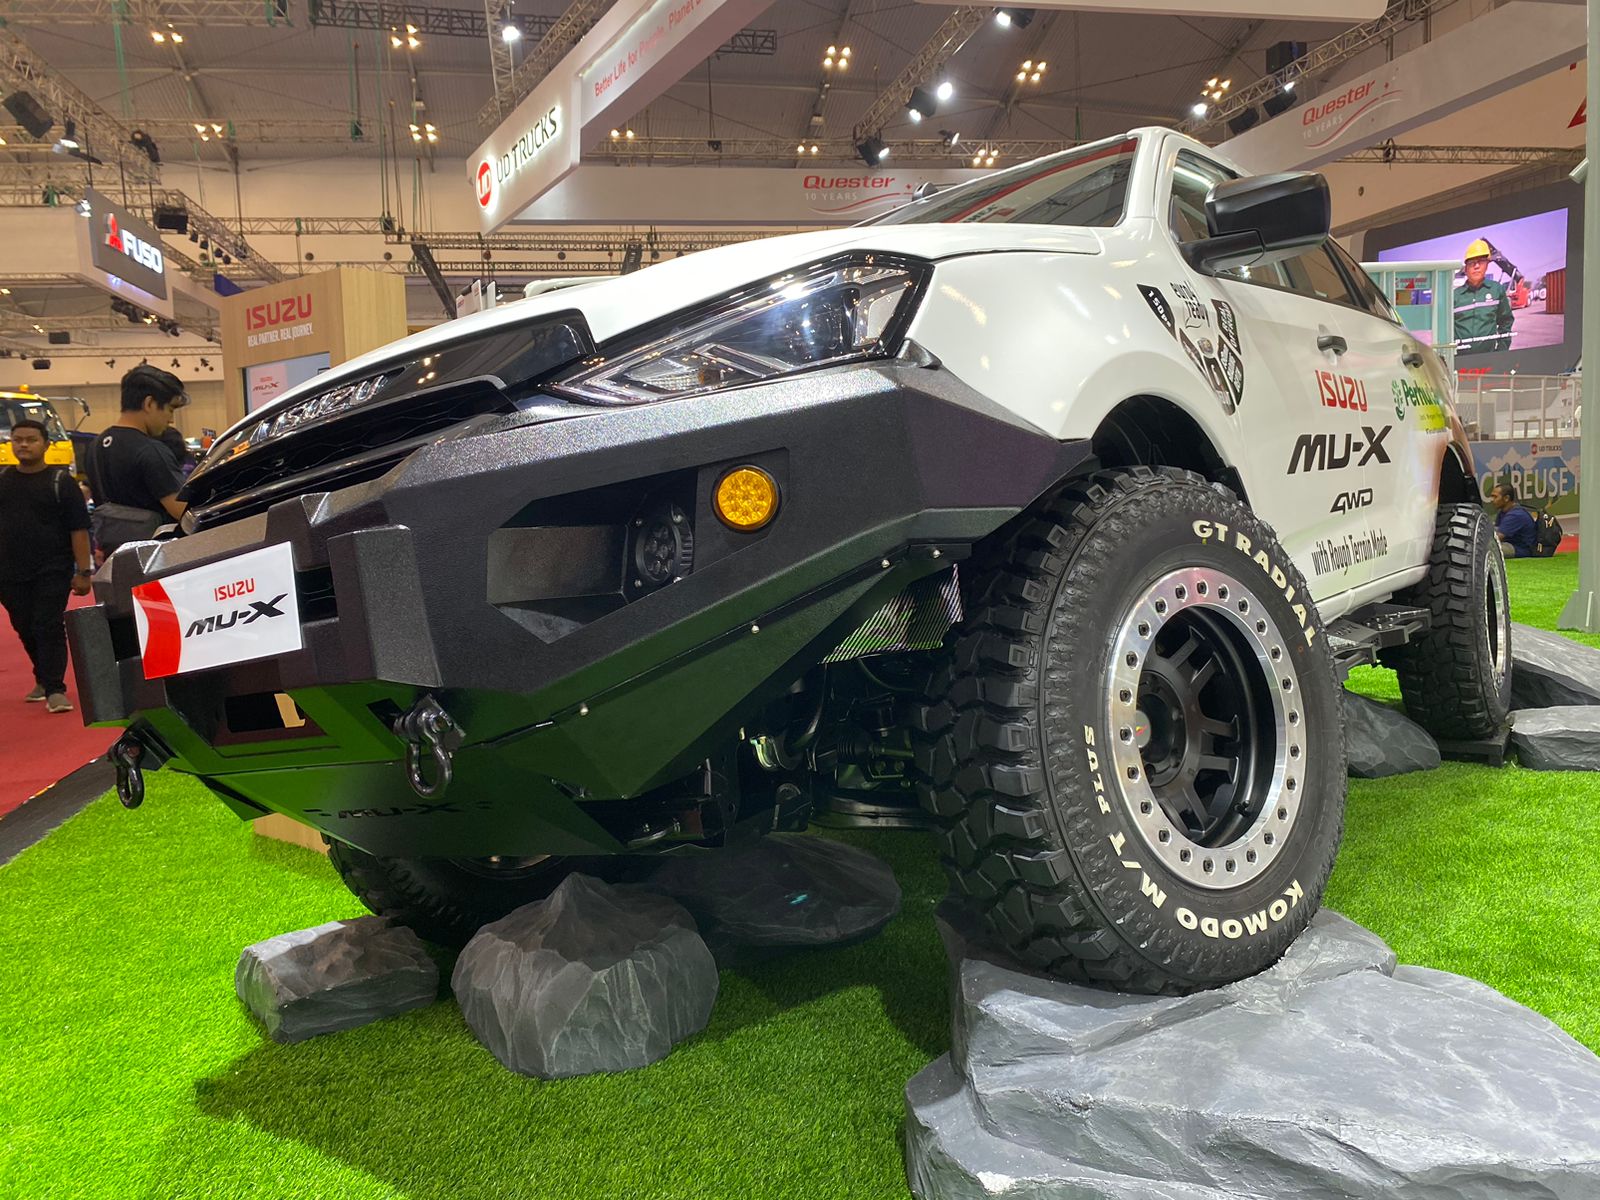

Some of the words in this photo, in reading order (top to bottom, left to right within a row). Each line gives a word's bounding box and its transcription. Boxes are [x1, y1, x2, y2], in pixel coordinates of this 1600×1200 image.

[594, 73, 613, 97] Better
[614, 59, 627, 81] Life
[628, 49, 638, 68] for
[1302, 80, 1376, 126] Quester
[1315, 114, 1344, 132] YEARS
[496, 154, 511, 183] UD
[512, 106, 558, 169] TRUCKS
[803, 175, 896, 190] Quester
[805, 192, 817, 200] 10
[823, 192, 857, 200] YEARS
[120, 229, 163, 274] FUSO
[246, 293, 312, 330] ISUZU
[1315, 369, 1368, 412] ISUZU
[1287, 425, 1393, 475] MU-X
[1330, 488, 1374, 515] 4WD
[1510, 466, 1568, 500] REUSE
[1311, 540, 1331, 576] with
[1327, 535, 1352, 576] Rough
[1348, 531, 1373, 565] Terrain
[1369, 528, 1388, 559] Mode
[214, 578, 255, 602] ISUZU
[1192, 520, 1228, 542] GT
[1235, 532, 1316, 648] RADIAL
[184, 593, 289, 638] MU-X
[1084, 725, 1111, 815] PLUS
[1108, 831, 1168, 909] M/T
[1175, 879, 1304, 940] KOMODO
